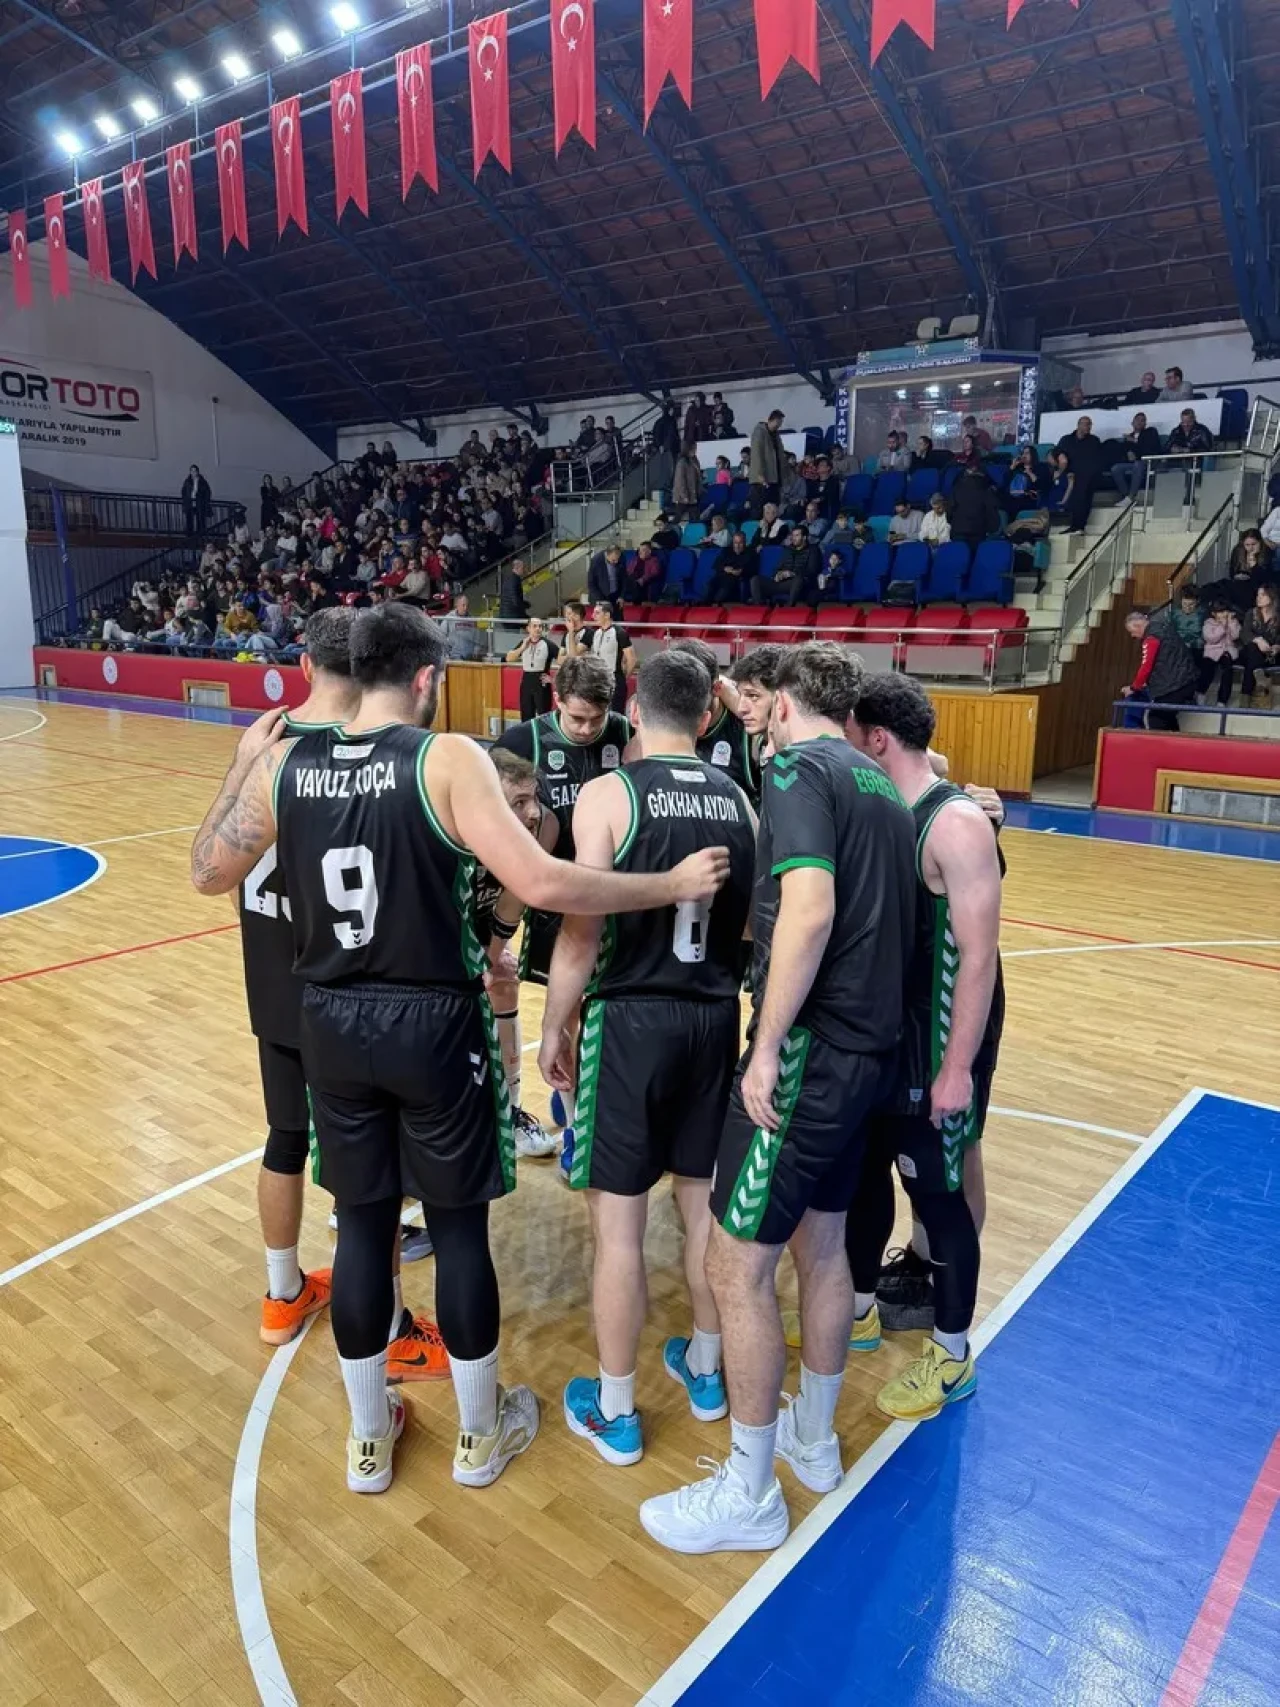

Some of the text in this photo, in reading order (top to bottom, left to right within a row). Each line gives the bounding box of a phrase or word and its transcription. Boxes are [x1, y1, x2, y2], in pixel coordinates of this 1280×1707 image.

[21, 432, 86, 447] ARALIK 2019
[60, 422, 122, 437] YAPILMIŞTIR
[647, 788, 739, 822] GÖKHAN AYDIN
[321, 845, 379, 949] 9
